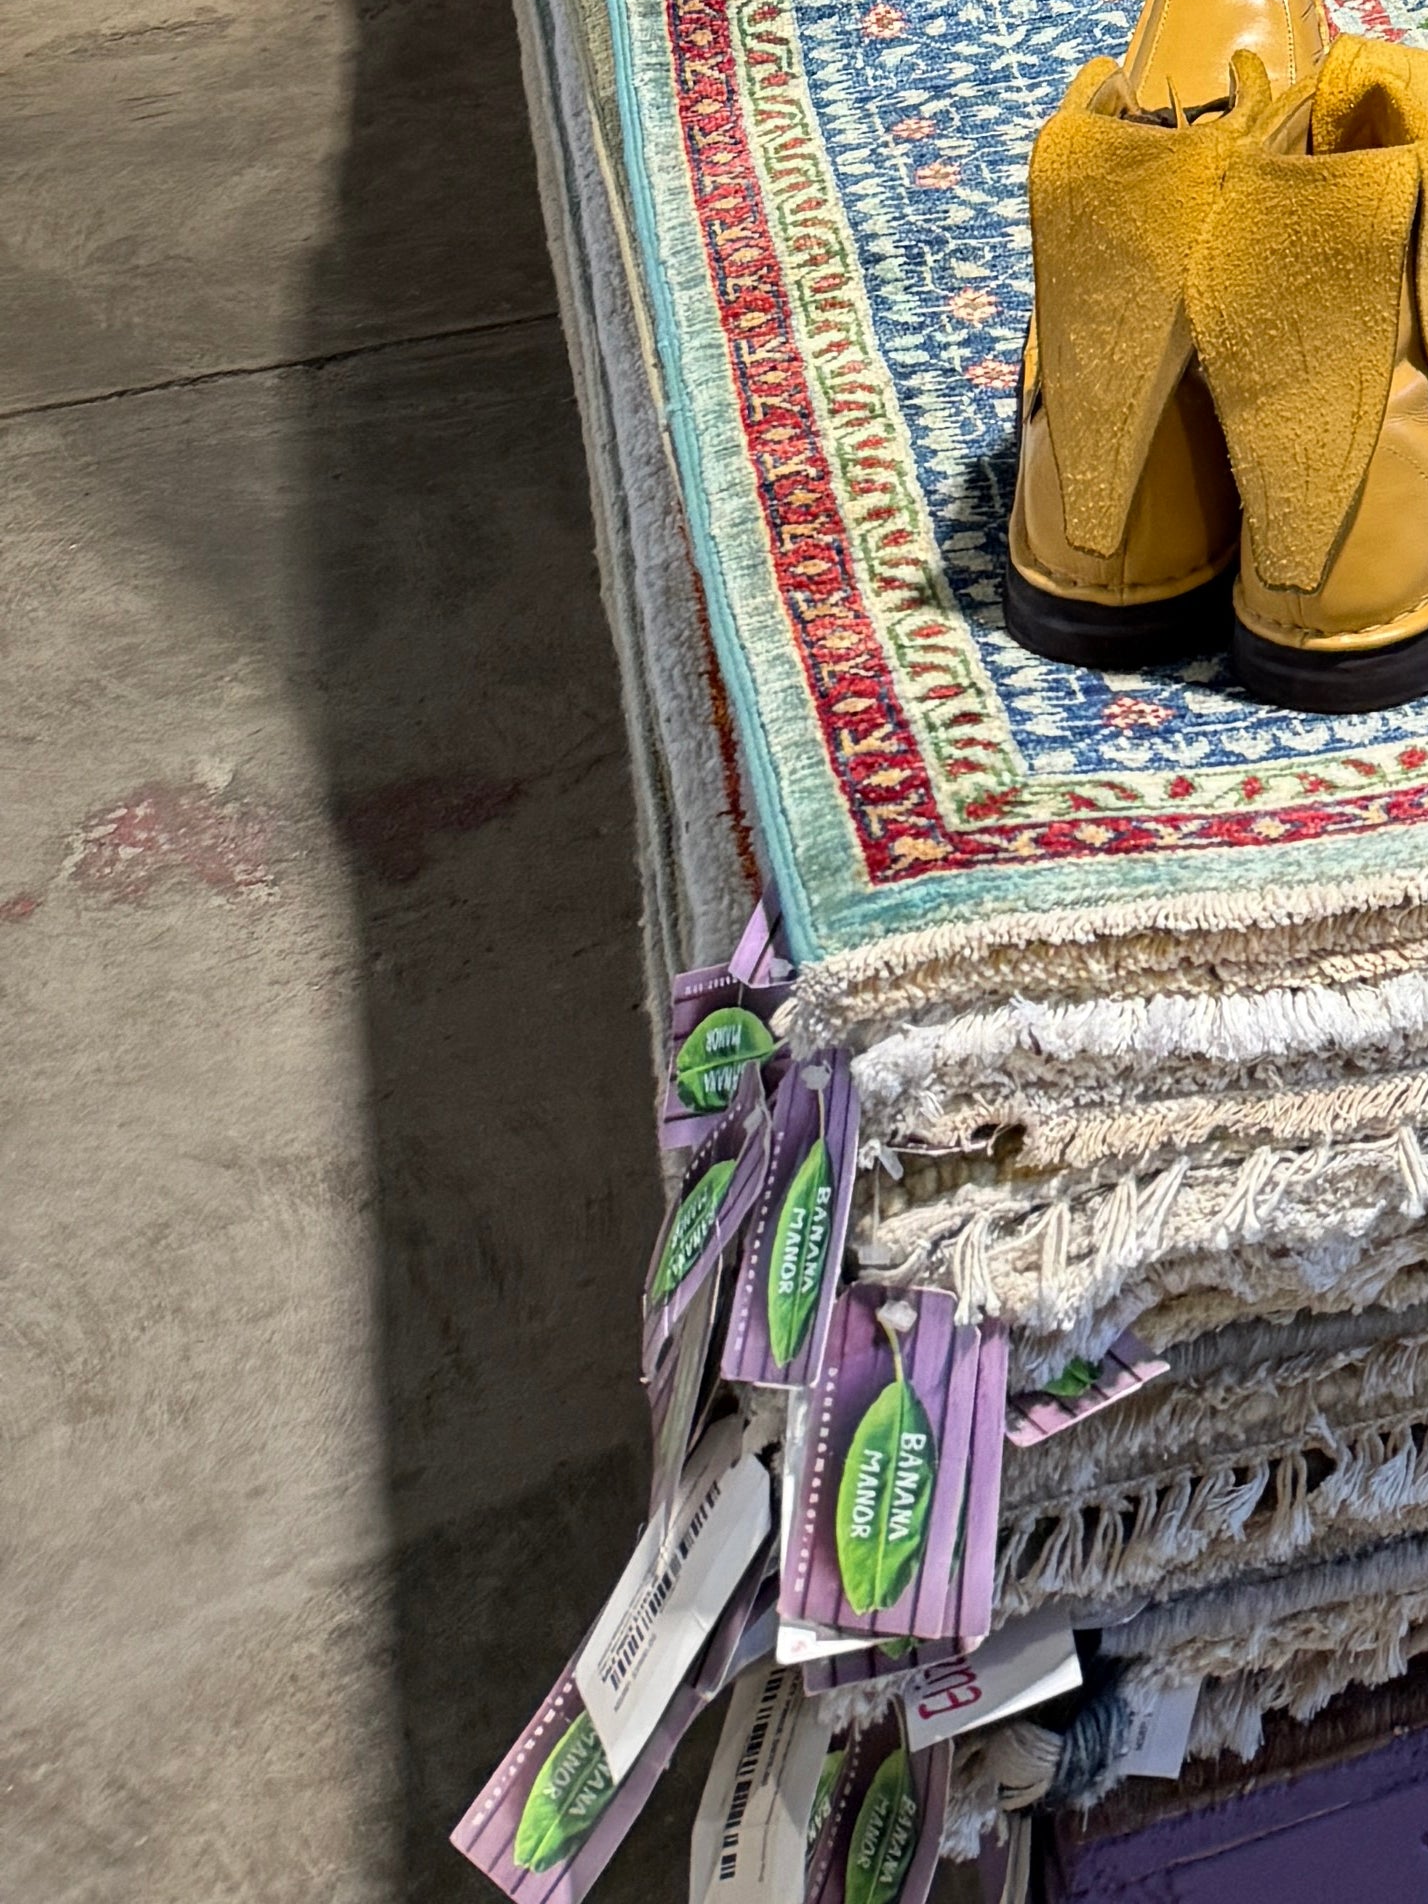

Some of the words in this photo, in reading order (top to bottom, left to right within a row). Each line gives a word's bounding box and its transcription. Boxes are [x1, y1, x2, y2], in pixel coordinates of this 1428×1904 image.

[778, 1207, 806, 1295] MANOR
[800, 1186, 832, 1294] BANANA
[850, 1449, 884, 1539] MANOR
[888, 1432, 927, 1542] BANANA
[857, 1794, 890, 1869] MANOR
[879, 1794, 917, 1883] BANANA
